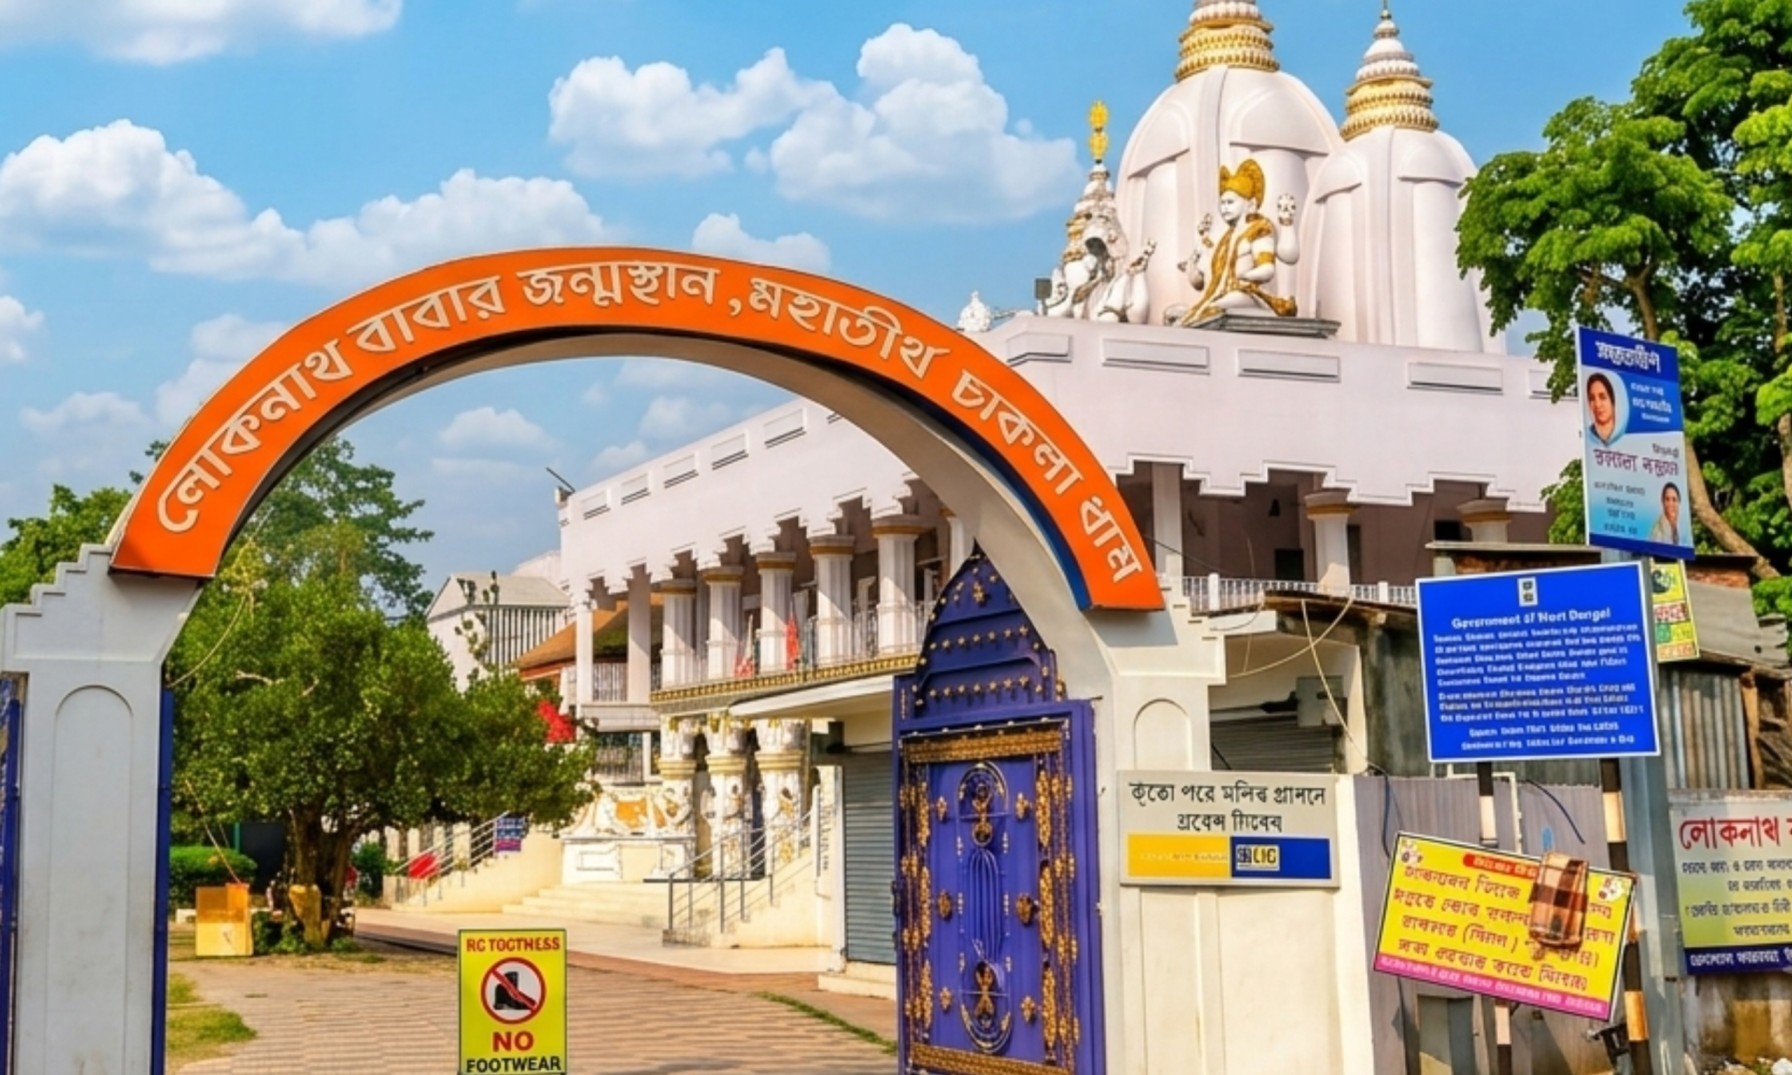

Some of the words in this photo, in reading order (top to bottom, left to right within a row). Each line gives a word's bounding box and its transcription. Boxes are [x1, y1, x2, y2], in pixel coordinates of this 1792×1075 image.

[157, 338, 353, 534] লোকনাথ
[346, 275, 506, 353] বাবার
[516, 260, 719, 308] জন্মস্থান
[950, 368, 1085, 496] চাকলা
[1079, 495, 1144, 584] ধাম
[1680, 816, 1781, 850] লোকনাথ
[492, 1030, 534, 1053] NO
[466, 1056, 562, 1074] FOOTWEAR
